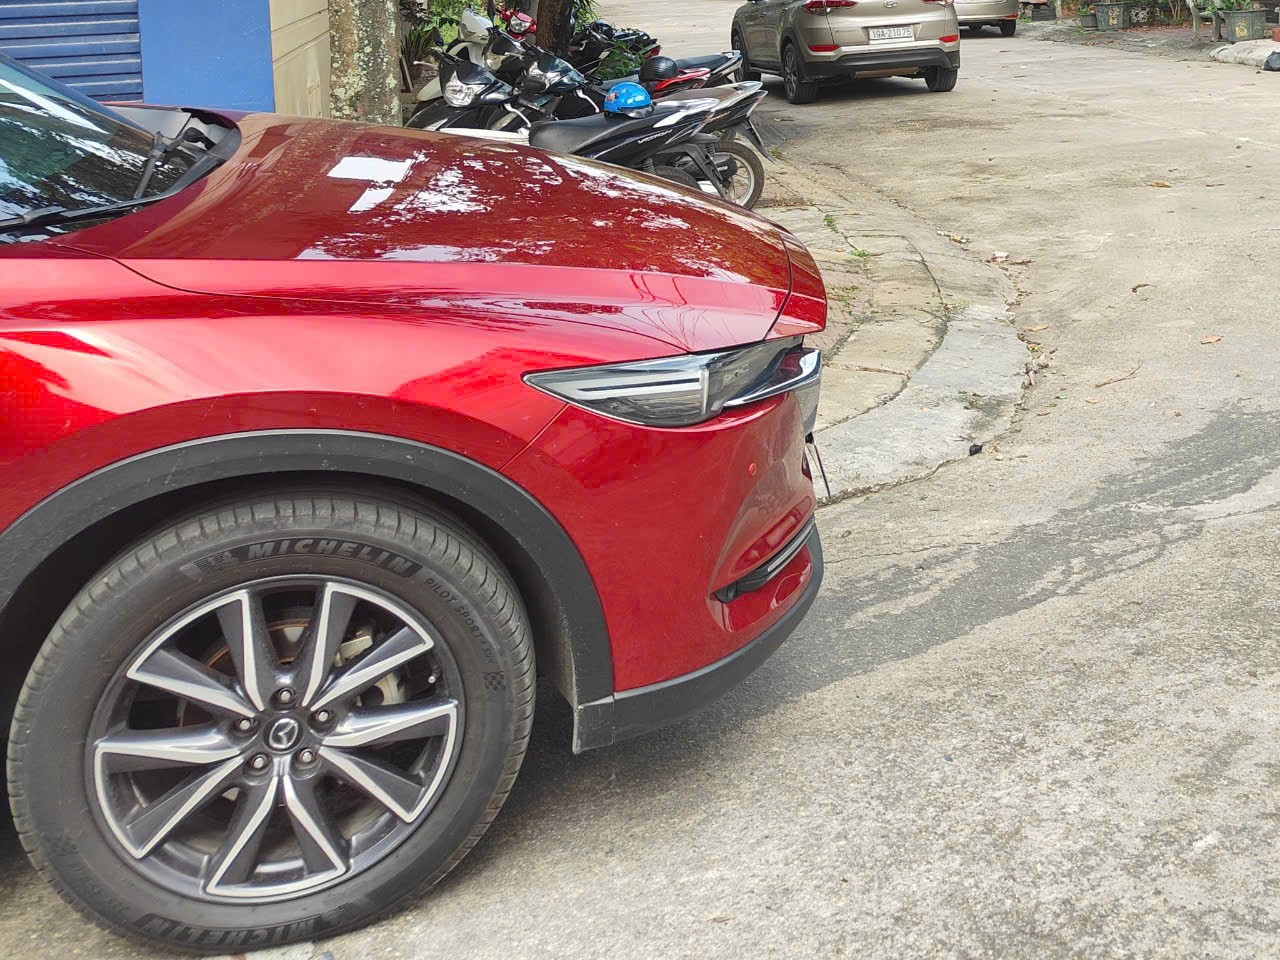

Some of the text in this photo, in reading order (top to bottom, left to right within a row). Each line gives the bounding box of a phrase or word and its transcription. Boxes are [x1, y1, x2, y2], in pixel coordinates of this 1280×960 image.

[249, 538, 414, 576] MICHELIN
[424, 578, 457, 603] PILOT
[455, 606, 484, 638] SPORT
